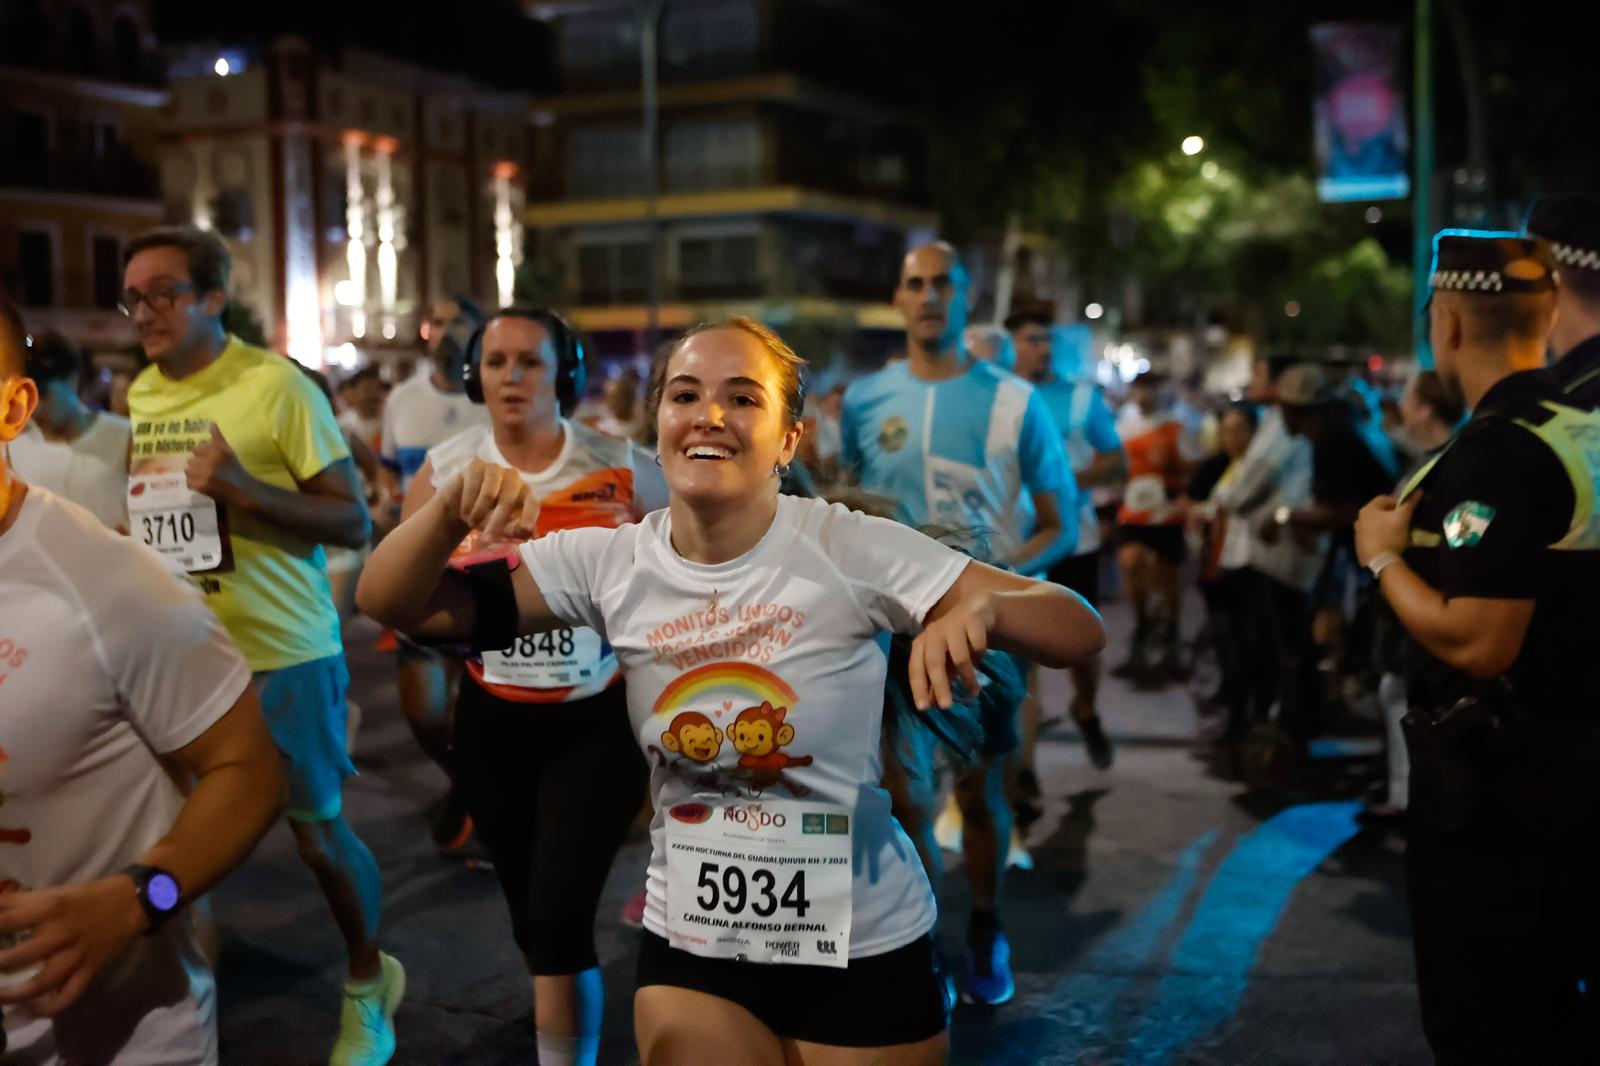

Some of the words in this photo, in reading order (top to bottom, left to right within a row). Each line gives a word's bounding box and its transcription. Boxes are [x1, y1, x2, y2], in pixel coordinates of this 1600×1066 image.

[142, 512, 194, 546] 3710
[646, 606, 730, 647] MONITOS
[671, 640, 774, 671] VENCIDOS
[695, 846, 732, 859] NOCTURNA
[733, 852, 747, 861] DEL
[748, 854, 807, 867] GUADALQUIVIR
[828, 857, 848, 866] 2025
[697, 862, 811, 918] 5934
[683, 913, 729, 929] CAROLINA
[731, 921, 783, 932] ALFONSO
[783, 922, 828, 933] BERNAL
